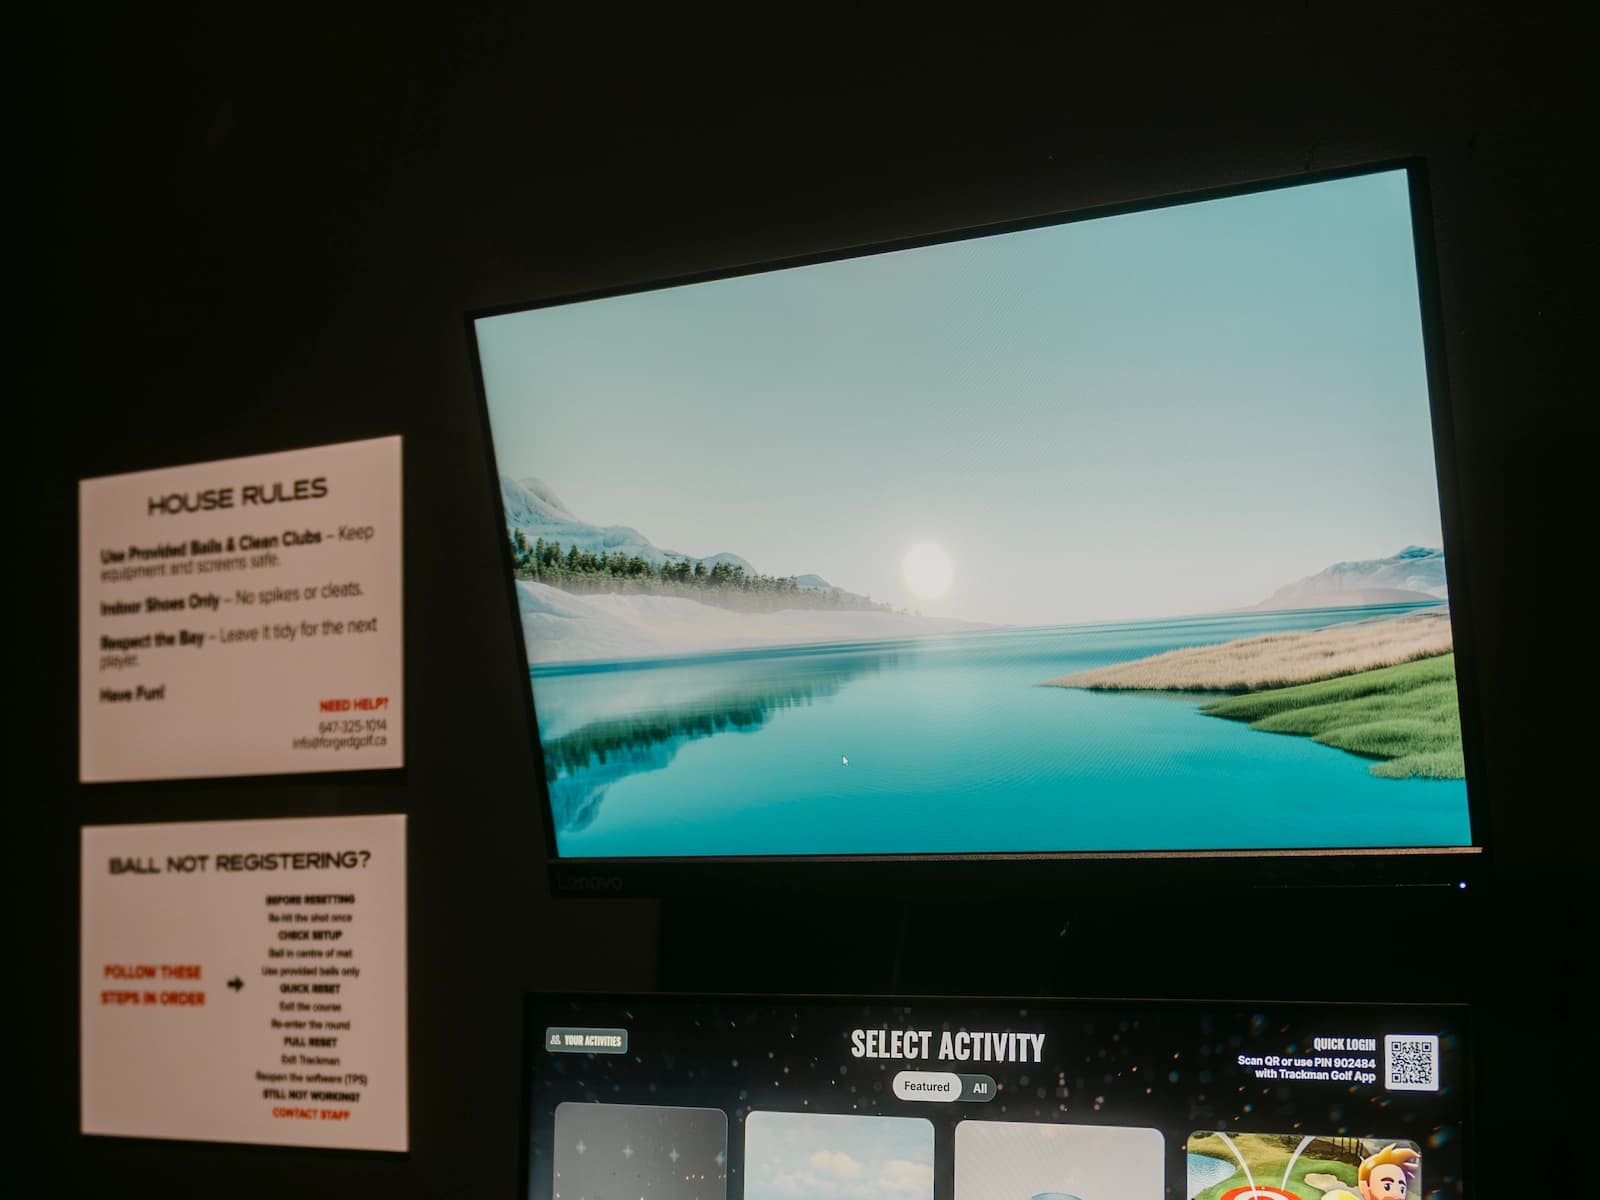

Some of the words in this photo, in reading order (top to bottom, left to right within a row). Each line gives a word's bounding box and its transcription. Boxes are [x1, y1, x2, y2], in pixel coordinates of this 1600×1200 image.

[147, 487, 234, 515] HOUSE
[241, 477, 328, 505] RULES
[100, 551, 125, 564] Use
[128, 543, 187, 560] Provided
[190, 539, 222, 556] Balls
[238, 535, 278, 551] Clean
[281, 529, 322, 547] Clubs
[338, 525, 374, 541] Keep
[100, 563, 166, 583] equipment
[169, 560, 194, 576] and
[196, 557, 247, 574] screens
[250, 551, 280, 568] safe.
[100, 601, 141, 616] Indoor
[144, 597, 185, 613] Shoes
[188, 593, 220, 611] Only
[235, 590, 255, 604] No
[258, 587, 301, 605] spikes
[302, 586, 318, 600] or
[320, 581, 363, 599] cleats.
[100, 634, 151, 651] Respect
[153, 633, 176, 647] the
[178, 629, 204, 647] Bay
[220, 627, 259, 643] Leave
[262, 624, 270, 639] it
[272, 623, 297, 641] tidy
[299, 620, 319, 637] for
[321, 620, 344, 635] the
[347, 617, 377, 633] next
[99, 689, 132, 702] Have
[135, 685, 165, 701] Fun!
[319, 699, 350, 712] NEED
[352, 696, 389, 710] HELP?
[108, 857, 161, 875] BALL
[166, 854, 209, 873] NOT
[215, 850, 371, 871] REGISTERING?
[104, 965, 156, 979] FOLLOW
[160, 965, 200, 979] THESE
[100, 991, 140, 1004] STEPS
[143, 991, 157, 1003] IN
[160, 991, 204, 1005] ORDER
[564, 1034, 583, 1046] YOUR
[584, 1035, 622, 1048] ACTIVITIES
[851, 1029, 932, 1059] SELECT
[938, 1031, 1045, 1063] ACTIVITY
[1313, 1037, 1345, 1051] QUICK
[1346, 1038, 1376, 1051] LOGIN
[1237, 1055, 1263, 1065] Scan
[1264, 1055, 1280, 1066] QR
[1280, 1058, 1293, 1066] or
[1293, 1058, 1313, 1067] use
[1314, 1057, 1332, 1067] PIN
[1333, 1057, 1376, 1068] 902484
[1254, 1067, 1277, 1078] with
[1278, 1068, 1329, 1080] Trackman
[1330, 1070, 1353, 1080] Golf
[1353, 1070, 1376, 1083] App
[904, 1080, 950, 1092] Featured
[972, 1082, 987, 1094] All
